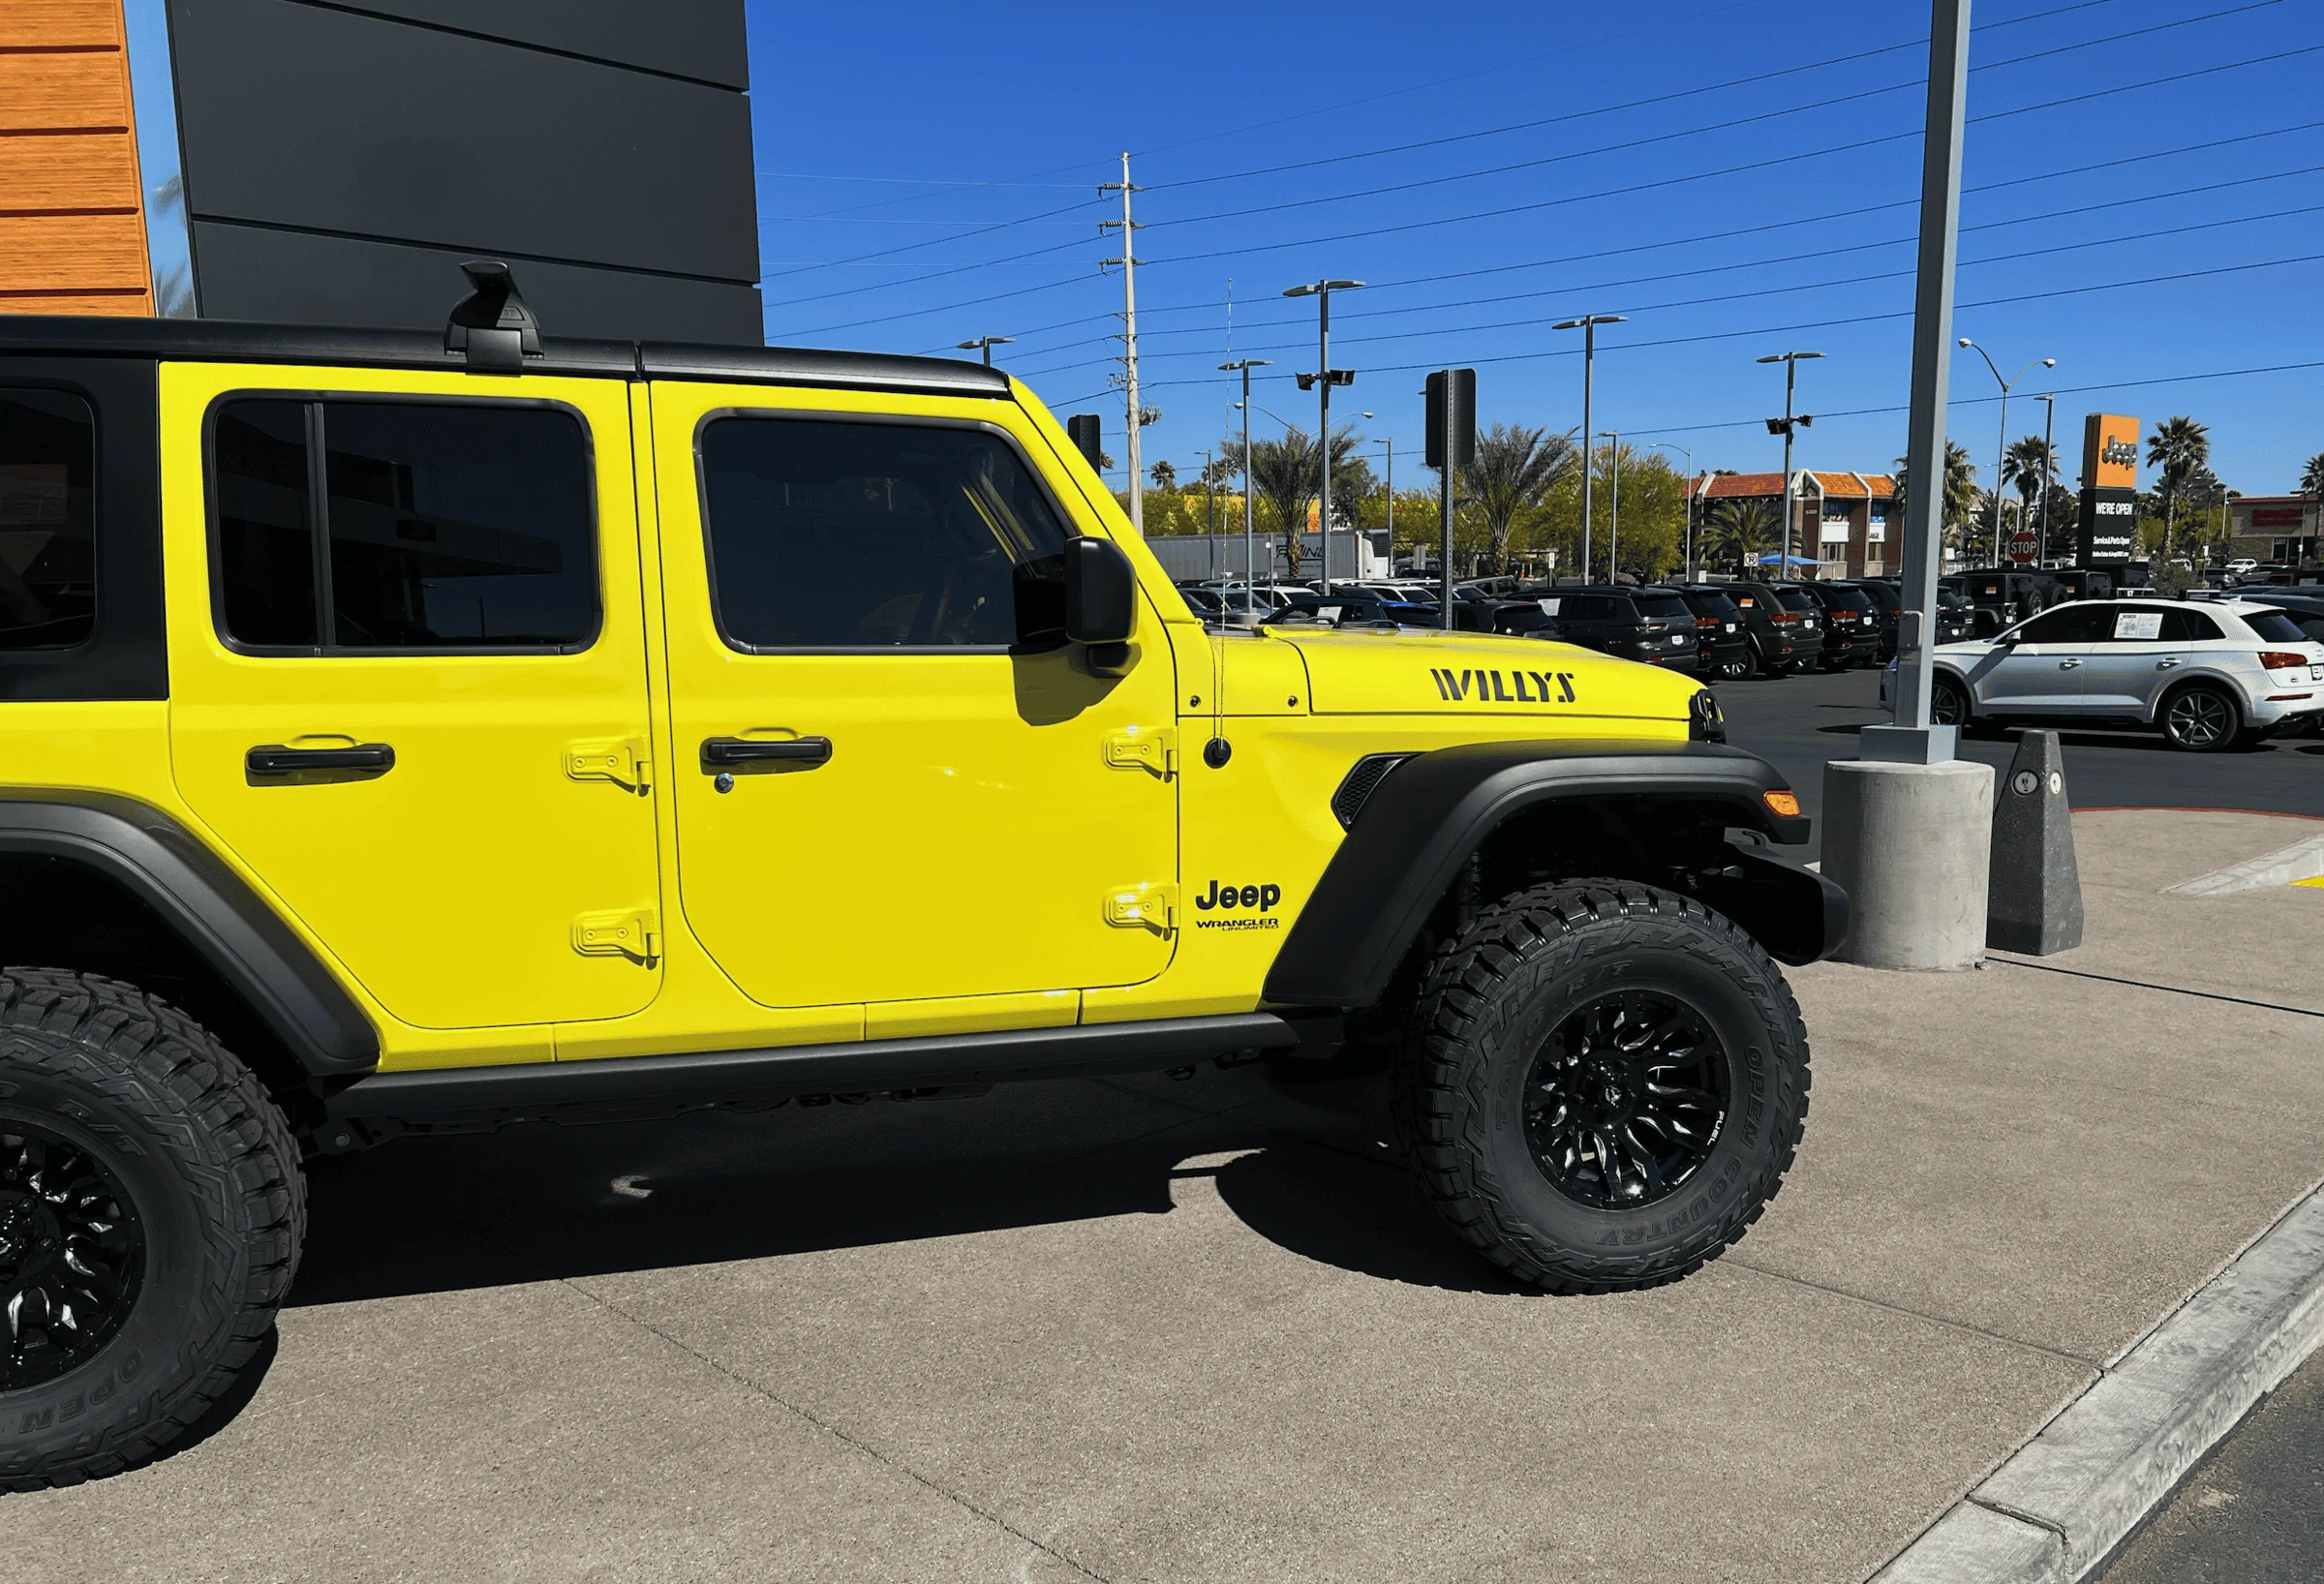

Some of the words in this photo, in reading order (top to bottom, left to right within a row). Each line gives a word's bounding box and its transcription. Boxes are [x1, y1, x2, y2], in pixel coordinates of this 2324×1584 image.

[2116, 503, 2133, 516] OPEN
[2011, 541, 2037, 554] STOP
[1429, 668, 1575, 703] WILLYS
[1195, 879, 1281, 912] Jeep
[1196, 918, 1278, 929] WRANGLER
[1740, 1046, 1765, 1150] OPEN
[1706, 1110, 1726, 1146] FUEL
[1596, 1154, 1744, 1247] COUNTRY
[18, 1348, 145, 1435] OPEN
